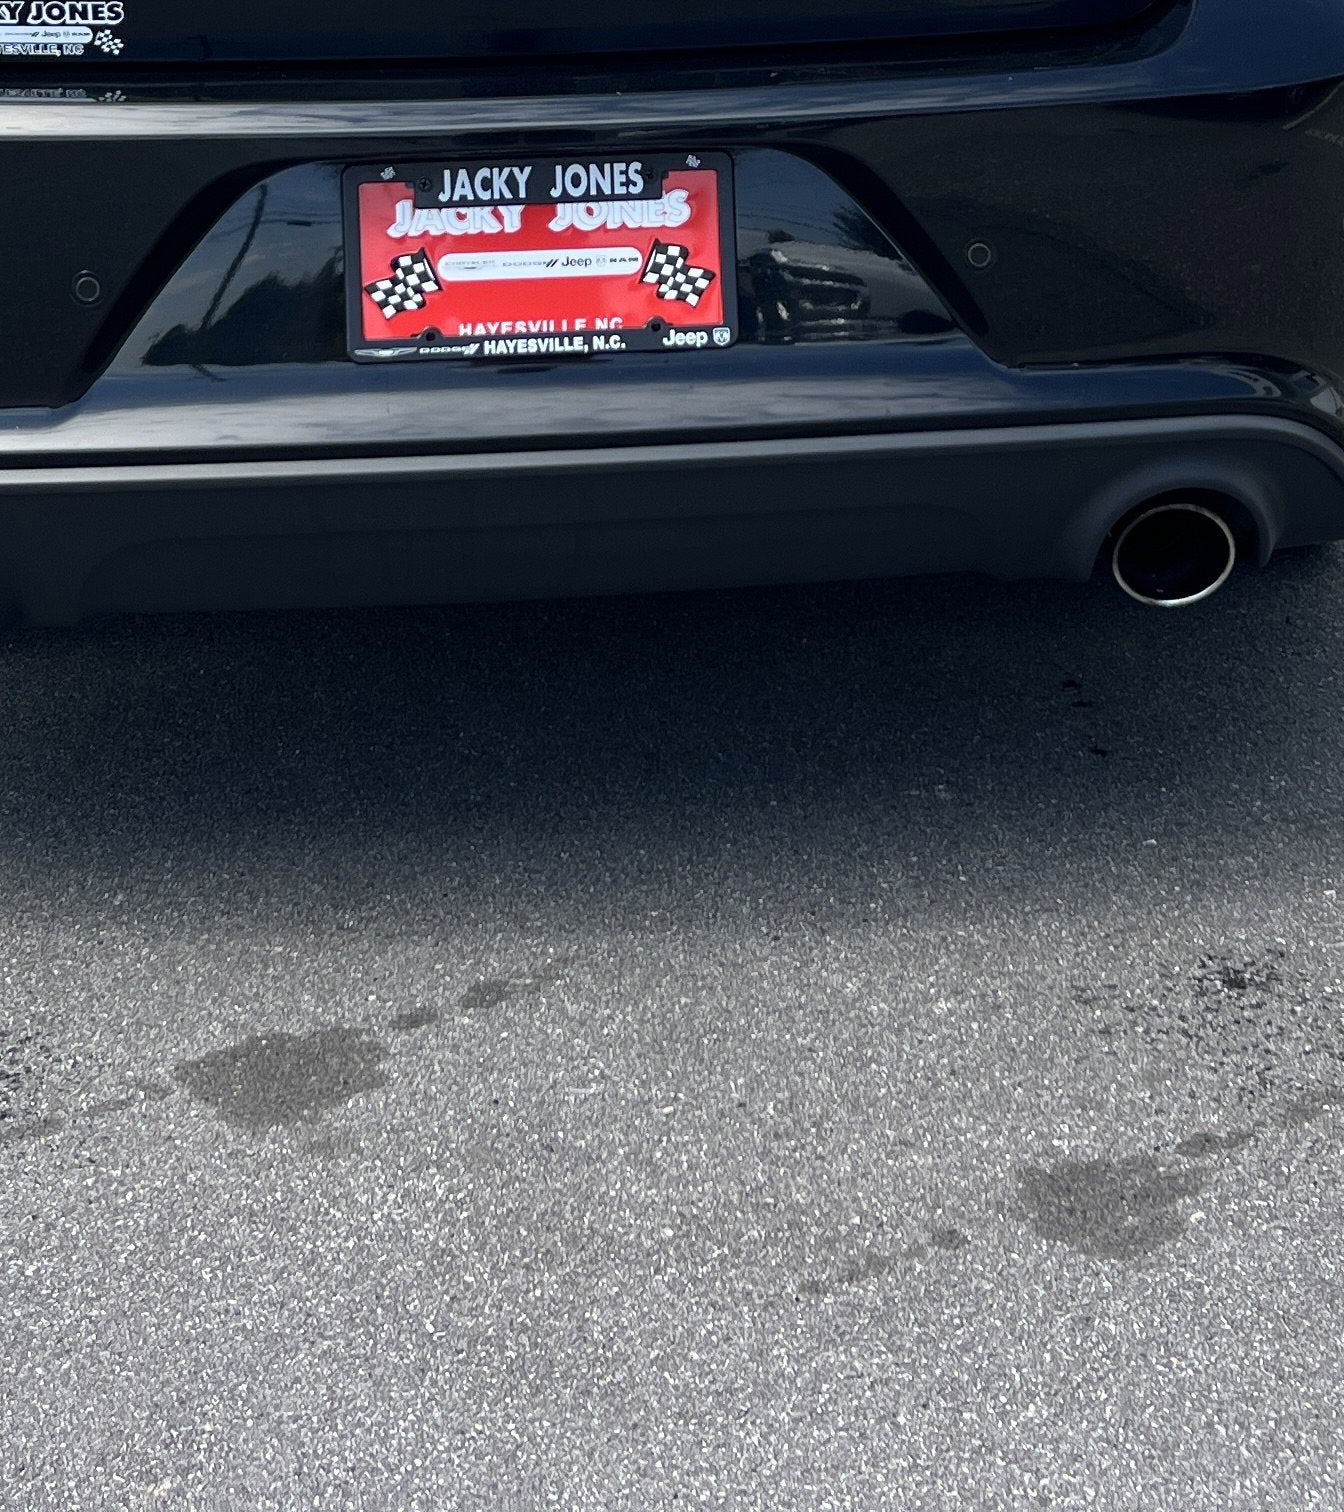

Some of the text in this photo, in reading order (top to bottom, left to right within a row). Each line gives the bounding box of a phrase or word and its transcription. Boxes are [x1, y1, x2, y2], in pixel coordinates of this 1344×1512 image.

[26, 1, 125, 25] JONES
[438, 161, 644, 203] JACKY JONES
[548, 189, 692, 232] JONES
[561, 256, 592, 269] Jeep
[484, 337, 589, 355] HAYESVILLE,
[592, 334, 626, 350] N.C.
[663, 329, 708, 348] Jeep
